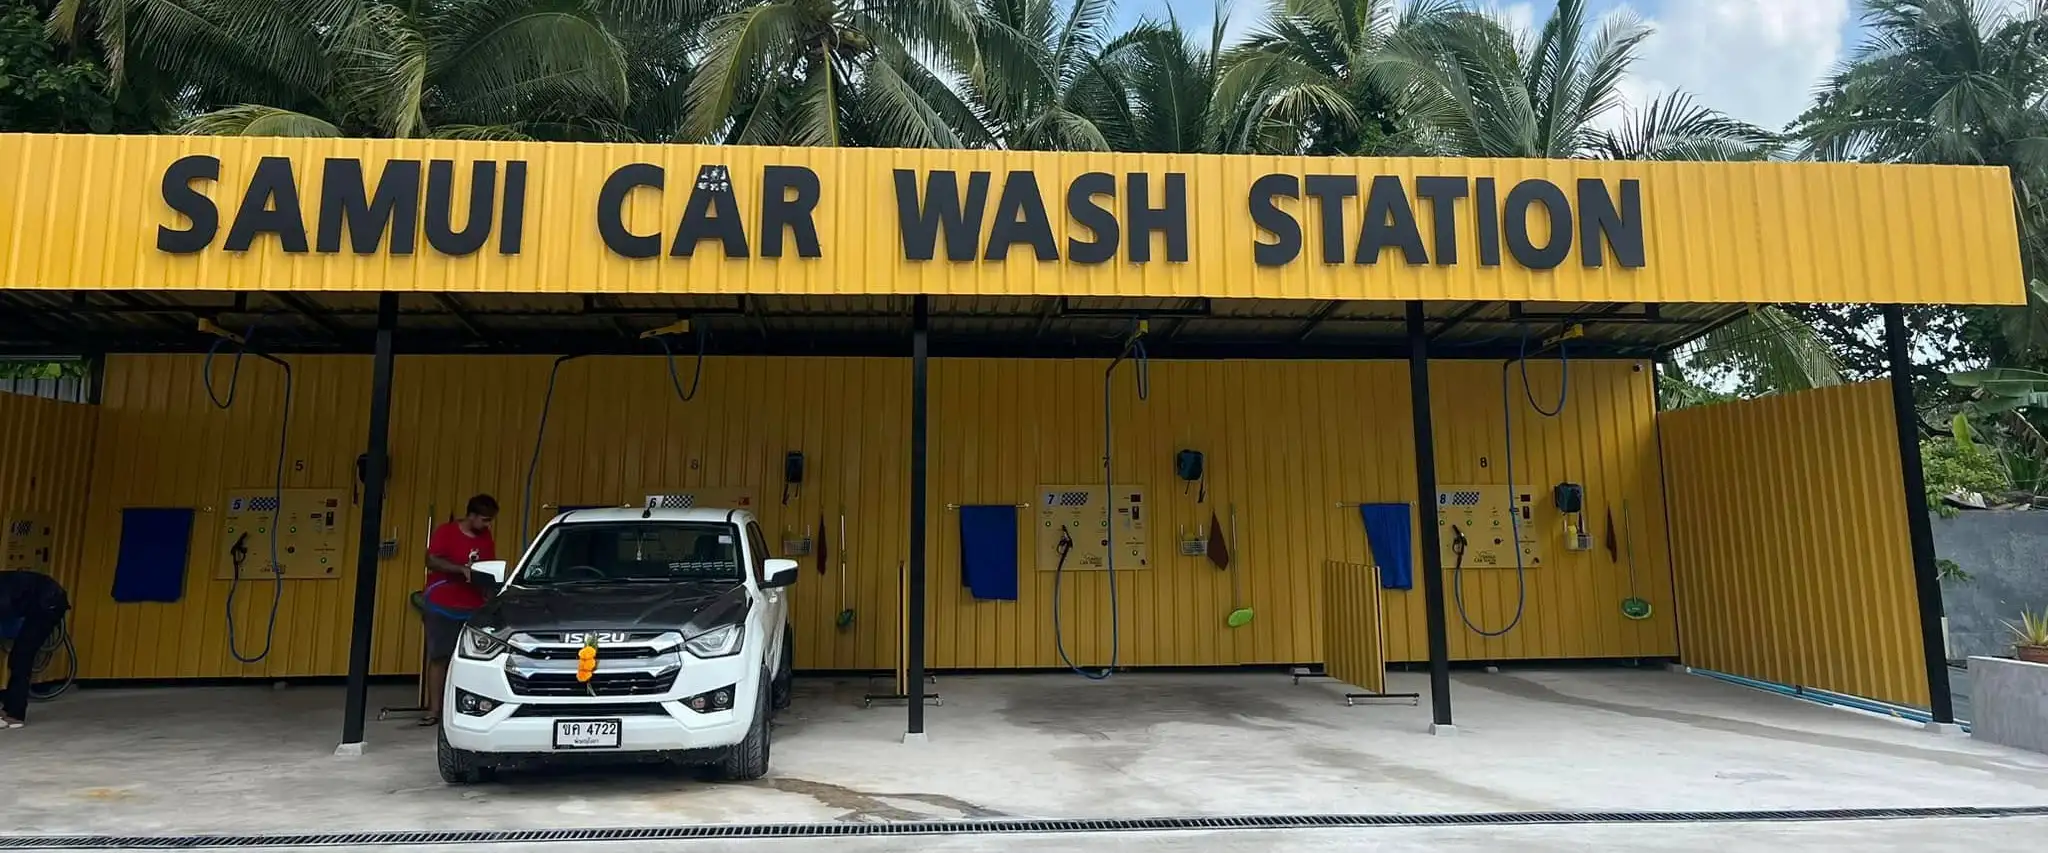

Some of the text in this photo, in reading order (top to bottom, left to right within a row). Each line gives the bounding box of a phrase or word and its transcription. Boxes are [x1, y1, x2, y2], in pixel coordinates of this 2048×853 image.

[156, 155, 1646, 270] SAMUI CAR WASH STATION
[295, 460, 303, 471] 5
[1480, 457, 1487, 468] 8
[233, 499, 241, 510] 5
[649, 497, 657, 509] 6
[1048, 494, 1055, 504] 7
[1440, 494, 1446, 504] 8
[587, 723, 616, 735] 4722
